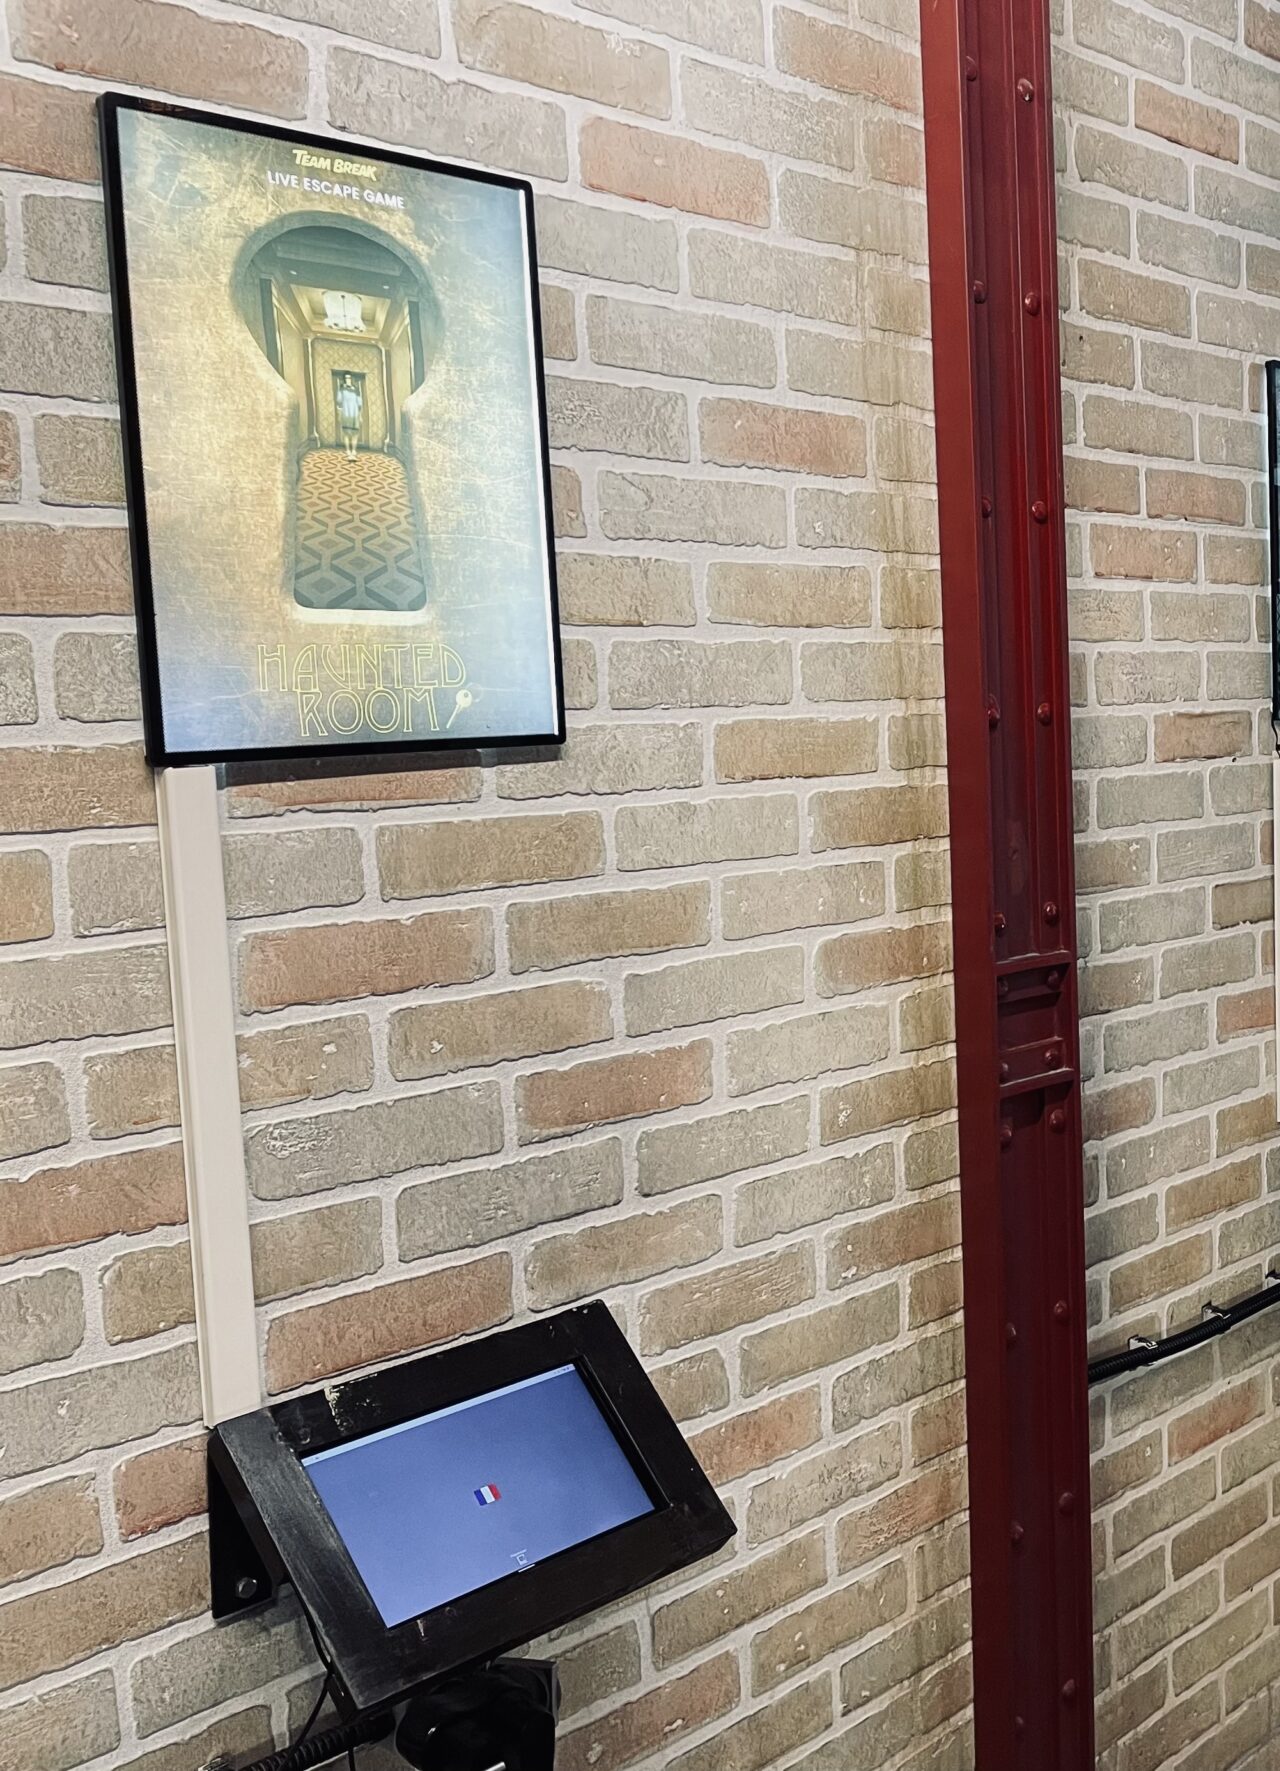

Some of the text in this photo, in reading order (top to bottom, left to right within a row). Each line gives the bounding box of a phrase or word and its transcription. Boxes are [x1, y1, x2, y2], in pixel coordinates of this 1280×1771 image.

[292, 149, 378, 181] TEAM BREAK
[267, 171, 405, 209] LIVE ESCAPE GAME
[257, 643, 466, 692] HAUNTED
[298, 687, 440, 736] ROOM
